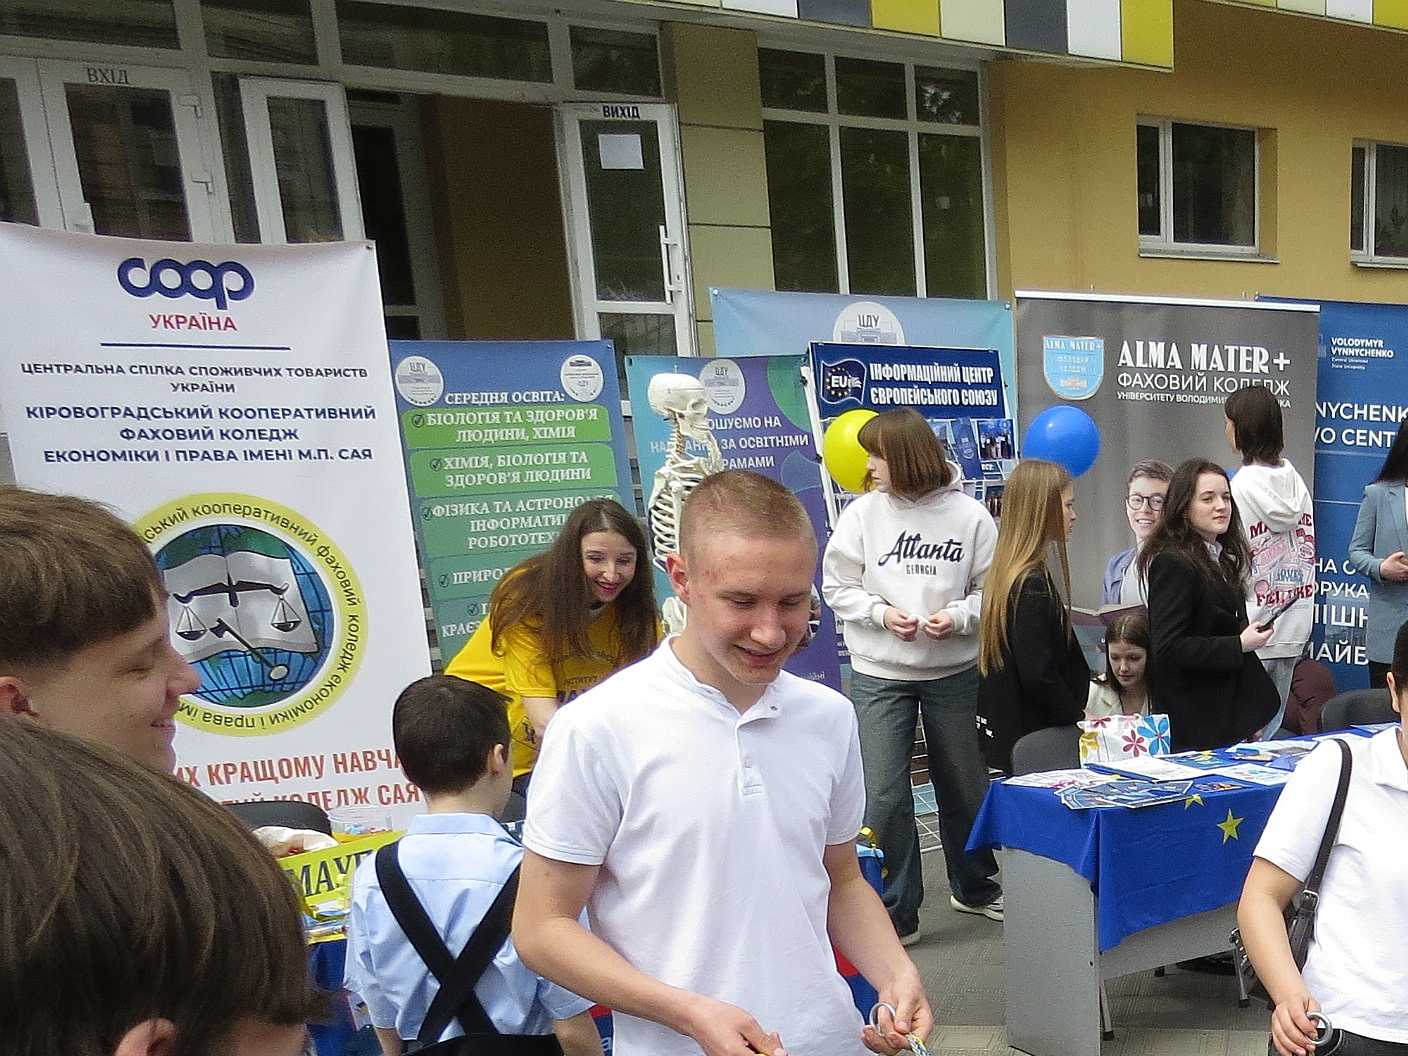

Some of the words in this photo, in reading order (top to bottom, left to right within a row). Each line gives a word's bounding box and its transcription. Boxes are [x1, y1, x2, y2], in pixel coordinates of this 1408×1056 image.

[87, 67, 130, 84] ВХІД
[602, 105, 641, 119] ВИХІД
[117, 257, 255, 310] coop
[149, 312, 238, 331] УКРАЇНА
[857, 314, 880, 329] ЦДУ
[1331, 337, 1384, 348] VOLODYMYR
[1117, 339, 1184, 371] ALMA
[1331, 346, 1394, 358] VYNNYCHENKO
[21, 363, 126, 375] ЦЕНТРАЛЬНА
[129, 364, 186, 375] СПІЛКА
[189, 366, 282, 377] СПОЖИВЧИХ
[286, 367, 368, 378] ТОВАРИСТВ
[869, 362, 962, 384] ІНФОРМАЦІЙНИЙ
[962, 366, 994, 385] ЦЕНТР
[170, 381, 236, 393] УКРАЇНИ
[1117, 372, 1207, 393] ФАХОВИЙ
[445, 391, 509, 405] СЕРЕДНЯ
[512, 390, 565, 403] ОСВІТА:
[870, 384, 961, 405] ЄВРОПЕЙСЬКОГО
[961, 389, 998, 406] СОЮЗУ
[1117, 392, 1175, 403] УНІВЕРСИТЕТУ
[26, 404, 213, 420] КІРОВОГРАДСЬКИЙ
[218, 404, 376, 419] КООПЕРАТИВНИЙ
[426, 411, 502, 426] БІОЛОГІЯ
[504, 410, 523, 423] ТА
[764, 416, 783, 429] НА
[120, 426, 214, 441] ФАХОВИЙ
[220, 428, 300, 442] КОЛЕДЖ
[456, 427, 529, 443] ЛЮДИНИ,
[533, 425, 577, 440] ХІМІЯ
[720, 438, 738, 450] ЗА
[739, 434, 810, 449] ОСВІТНІМИ
[1341, 428, 1397, 448] CENT
[44, 450, 160, 463] ЕКОНОМІКИ
[165, 450, 170, 462] І
[176, 449, 239, 462] ПРАВА
[243, 449, 293, 462] ІМЕНІ
[298, 449, 334, 461] М.П.
[338, 448, 374, 460] САЯ
[443, 455, 494, 471] ХІМІЯ,
[497, 452, 568, 468] БІОЛОГІЯ
[570, 451, 589, 464] ТА
[524, 467, 593, 484] ЛЮДИНИ
[432, 502, 489, 518] ФІЗИКА
[494, 501, 513, 514] ТА
[192, 502, 319, 546] кооперативний
[878, 529, 964, 567] Atlanta
[316, 545, 361, 607] фаховий
[906, 564, 937, 576] GEORGIA
[336, 614, 361, 674] коледж
[268, 672, 343, 726] економіки
[202, 710, 257, 728] права
[207, 754, 325, 785] КРАЩОМУ
[378, 783, 421, 805] САЯ
